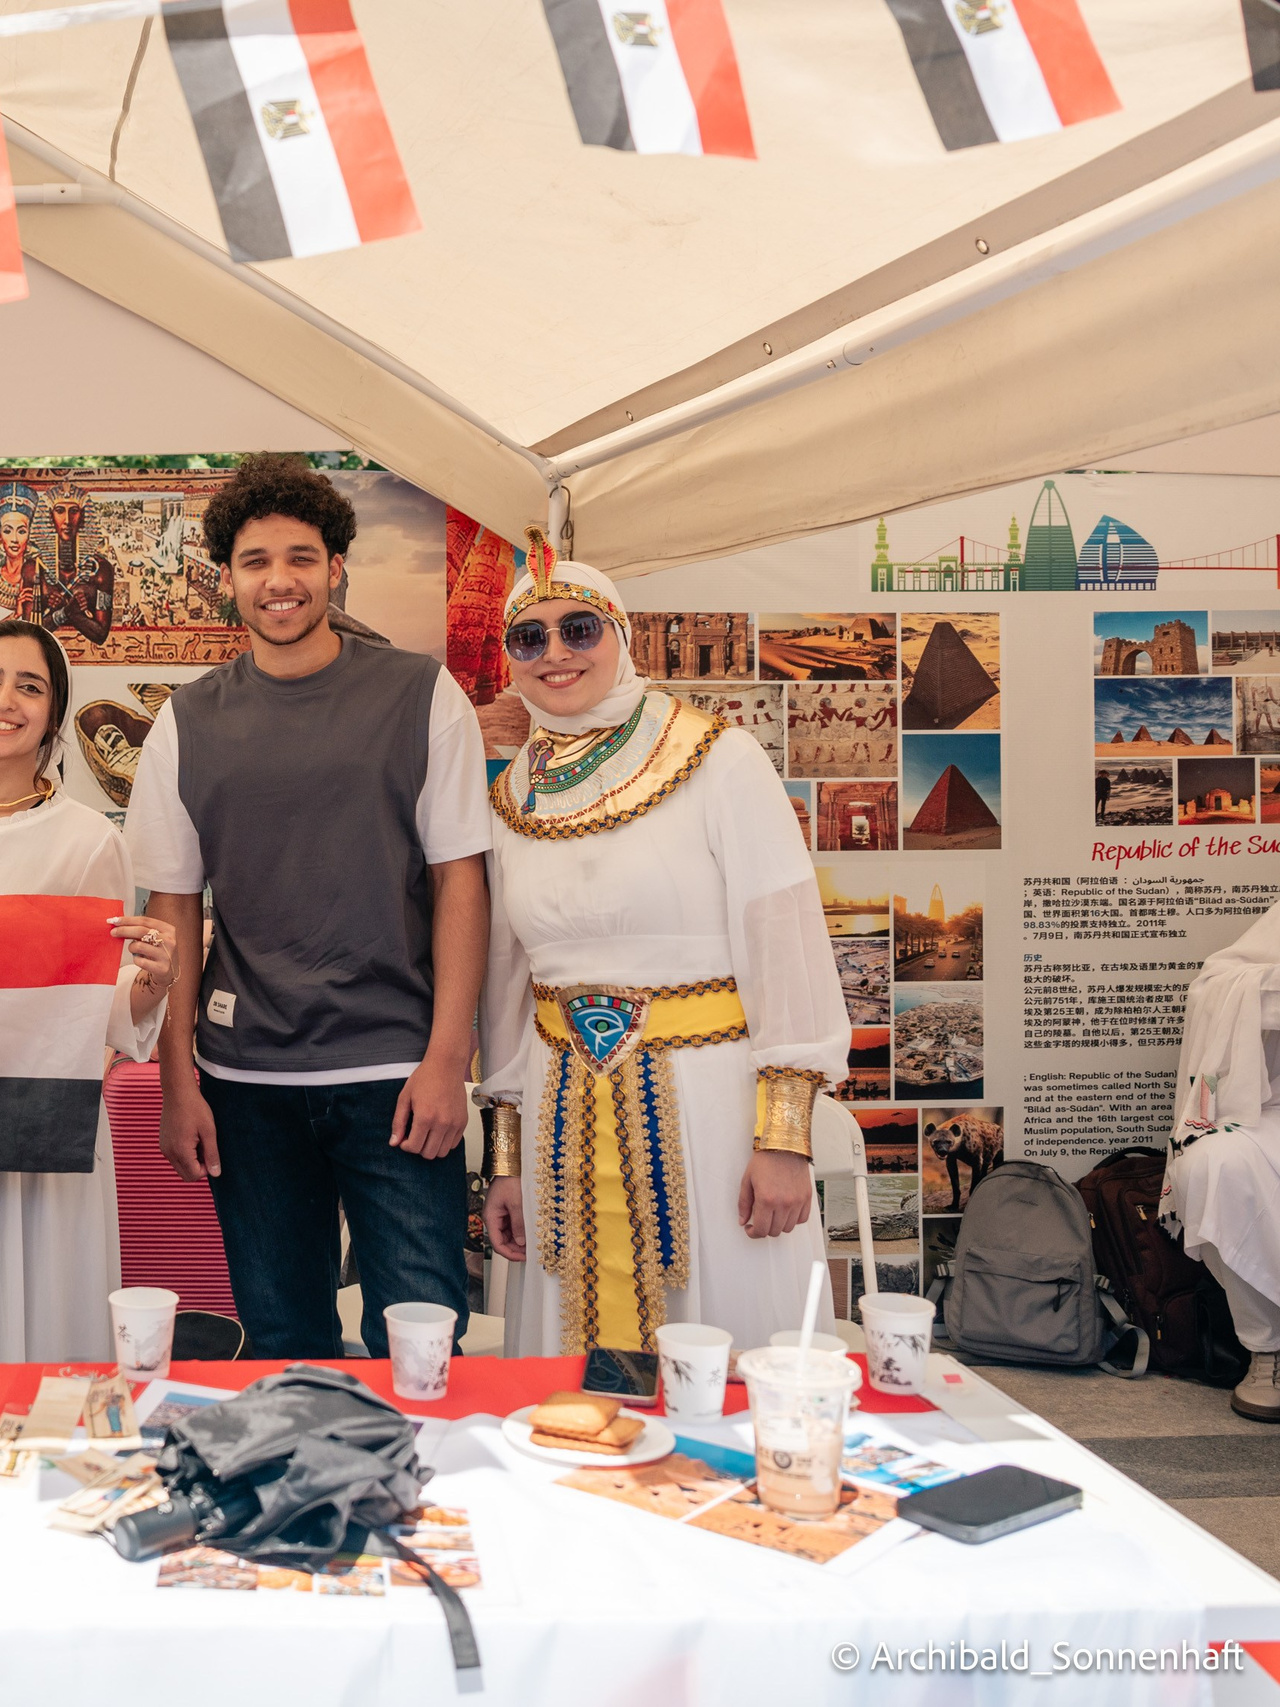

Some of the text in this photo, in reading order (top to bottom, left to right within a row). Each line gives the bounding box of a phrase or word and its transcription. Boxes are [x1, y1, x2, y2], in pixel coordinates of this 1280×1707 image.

[1092, 835, 1280, 870] Republic of the Su
[1061, 887, 1103, 897] Republic
[1105, 887, 1115, 895] of
[1118, 887, 1133, 895] the
[1023, 953, 1043, 962] 历史
[1023, 974, 1075, 984] 极大的破坏。
[1023, 1027, 1184, 1038] 自己的陵墓。自他以后，第25王朝及
[1029, 1072, 1067, 1082] English:
[1069, 1072, 1111, 1081] Republic
[1113, 1071, 1124, 1079] of
[1126, 1071, 1142, 1079] the
[1144, 1070, 1177, 1079] Sudan)
[1046, 1083, 1099, 1092] sometimes
[1101, 1082, 1131, 1090] called
[1134, 1082, 1161, 1090] North
[1023, 1095, 1042, 1103] and
[1044, 1094, 1054, 1102] at
[1057, 1094, 1073, 1102] the
[1076, 1093, 1113, 1102] eastern
[1115, 1093, 1134, 1101] end
[1136, 1092, 1147, 1100] of
[1150, 1092, 1166, 1100] the
[1023, 1116, 1052, 1124] Africa
[1077, 1115, 1093, 1123] the
[1120, 1114, 1155, 1123] largest
[1023, 1124, 1173, 1136] Muslim population, South Suda
[1023, 1138, 1034, 1146] of
[1036, 1137, 1107, 1146] independence.
[1132, 1135, 1154, 1143] 2011
[1023, 1149, 1038, 1157] On
[1040, 1148, 1058, 1158] July
[1060, 1148, 1070, 1157] 9,
[1089, 1147, 1125, 1157] Republ
